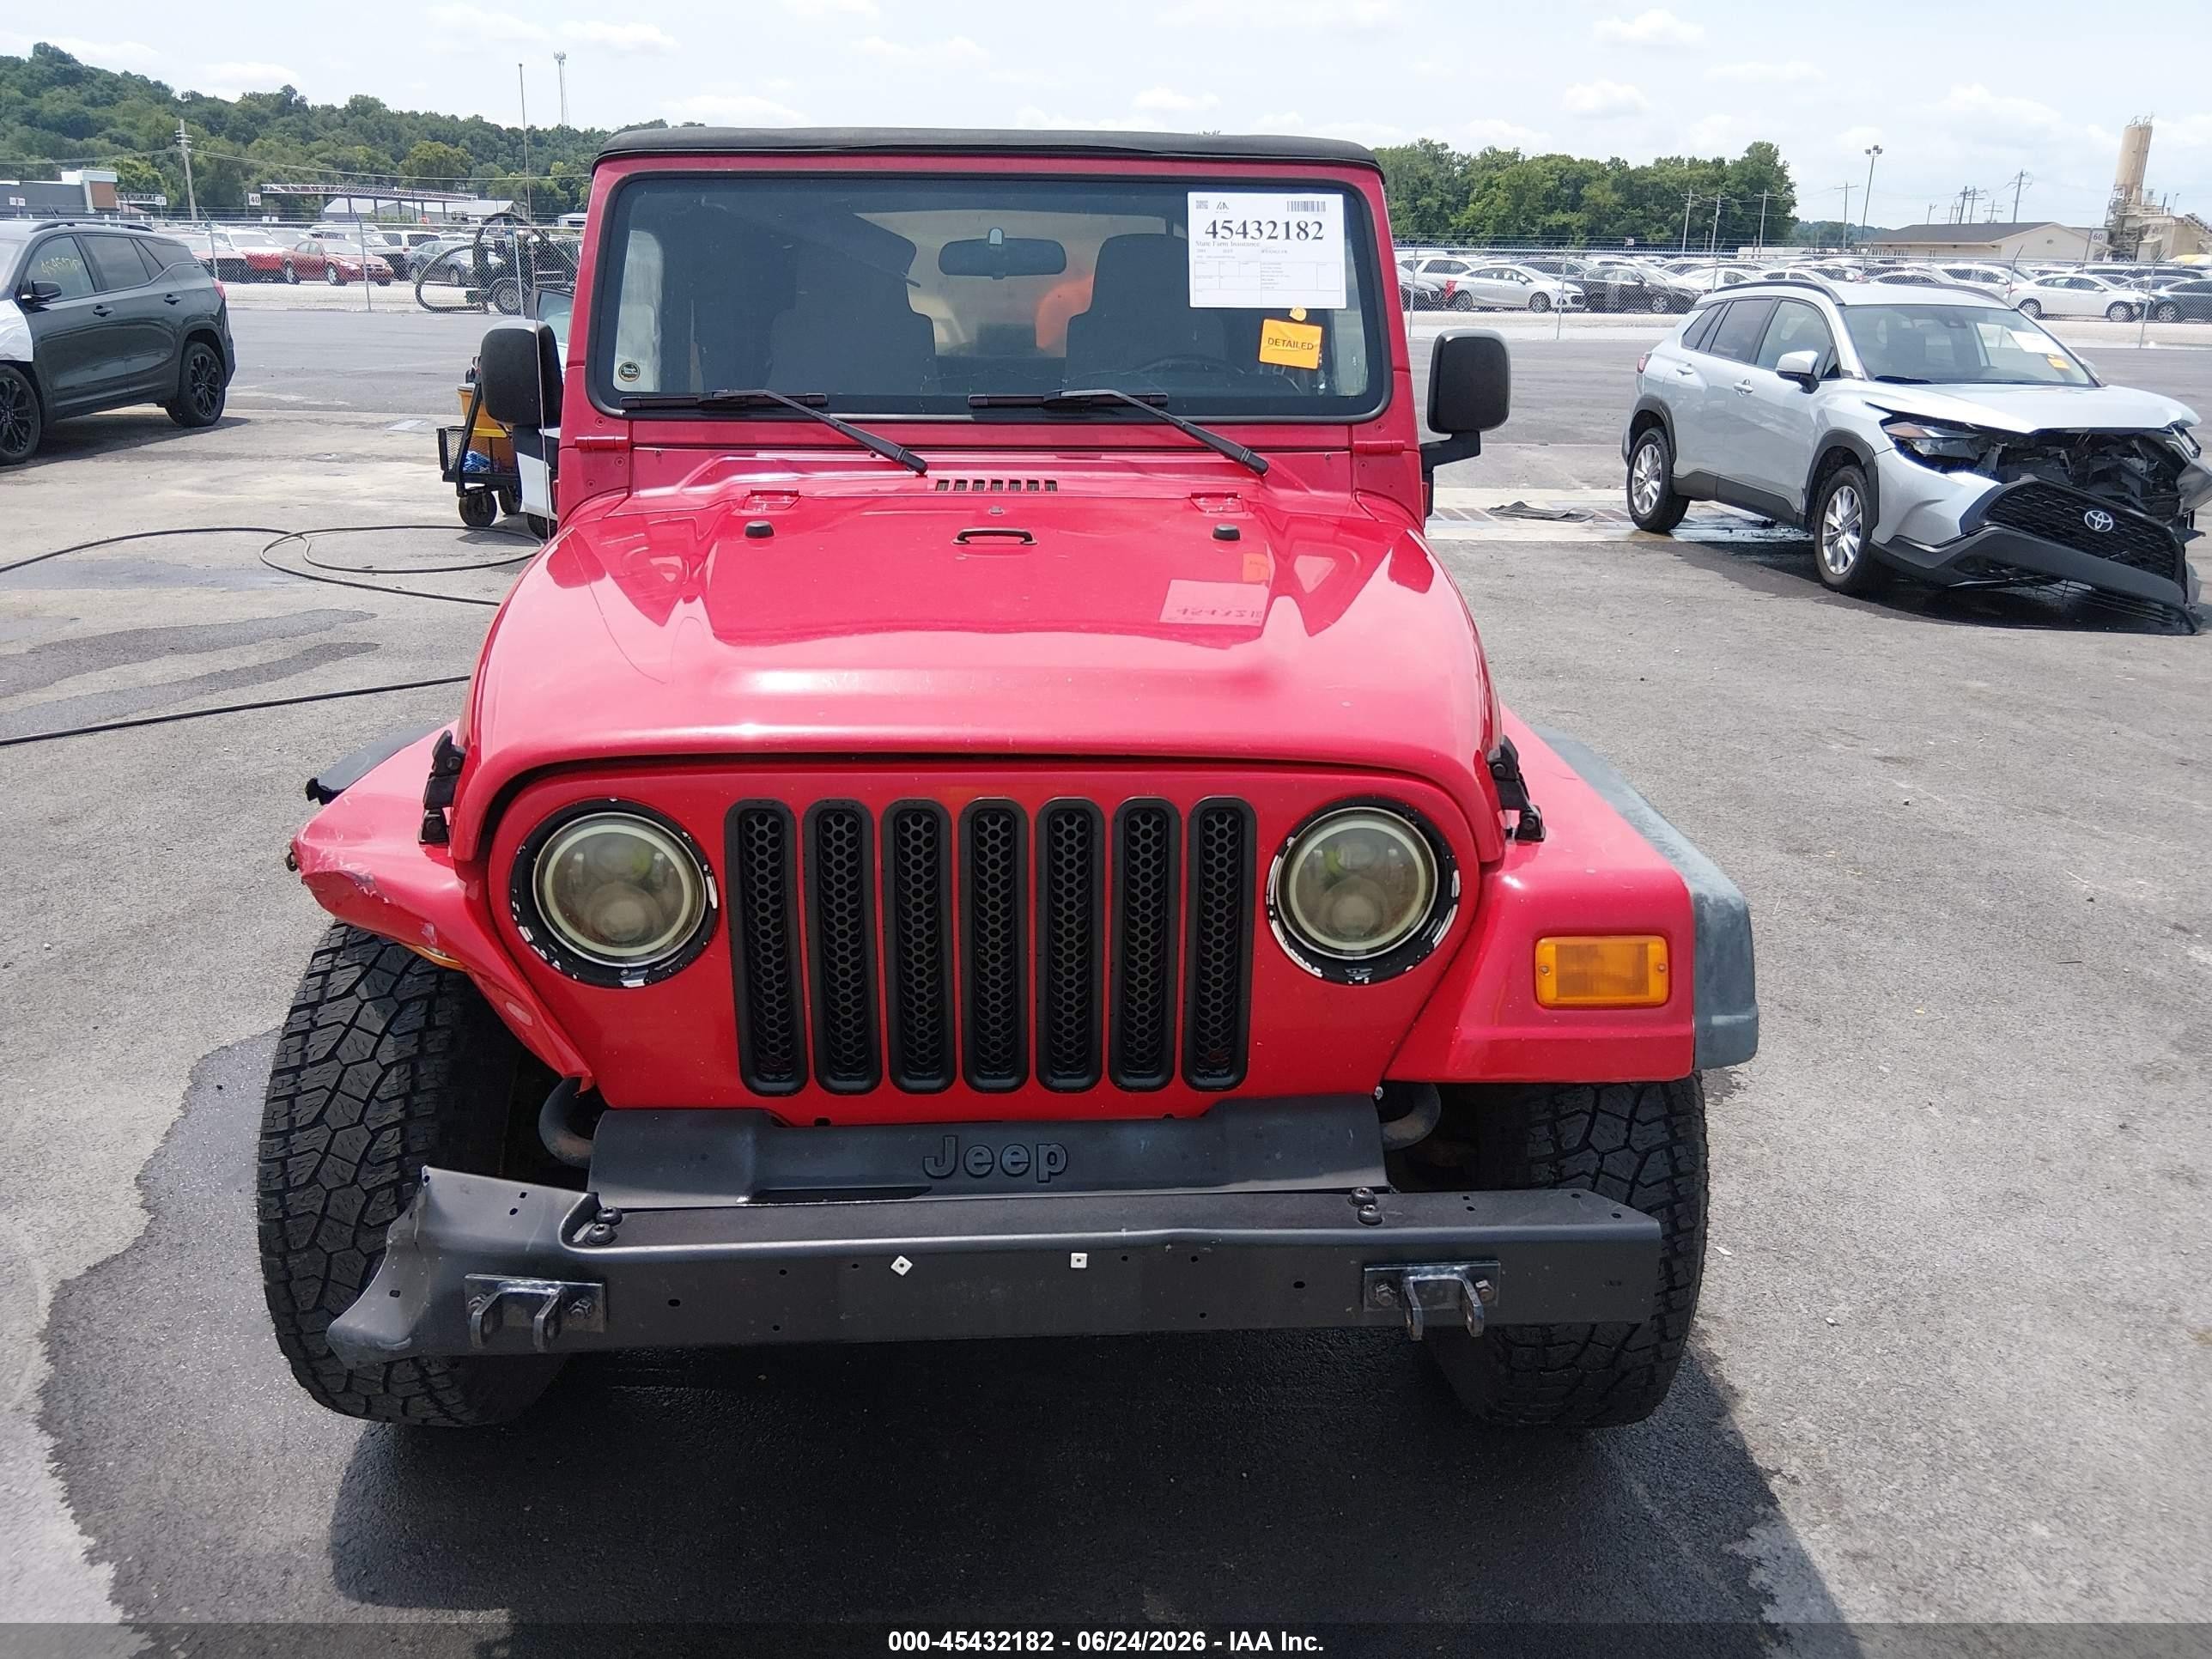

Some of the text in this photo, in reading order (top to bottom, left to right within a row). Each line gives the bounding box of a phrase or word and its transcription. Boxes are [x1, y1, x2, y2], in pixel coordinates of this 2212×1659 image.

[1205, 220, 1324, 240] 45432182
[1267, 337, 1314, 350] DETAILED
[922, 1135, 1068, 1183] Jeep
